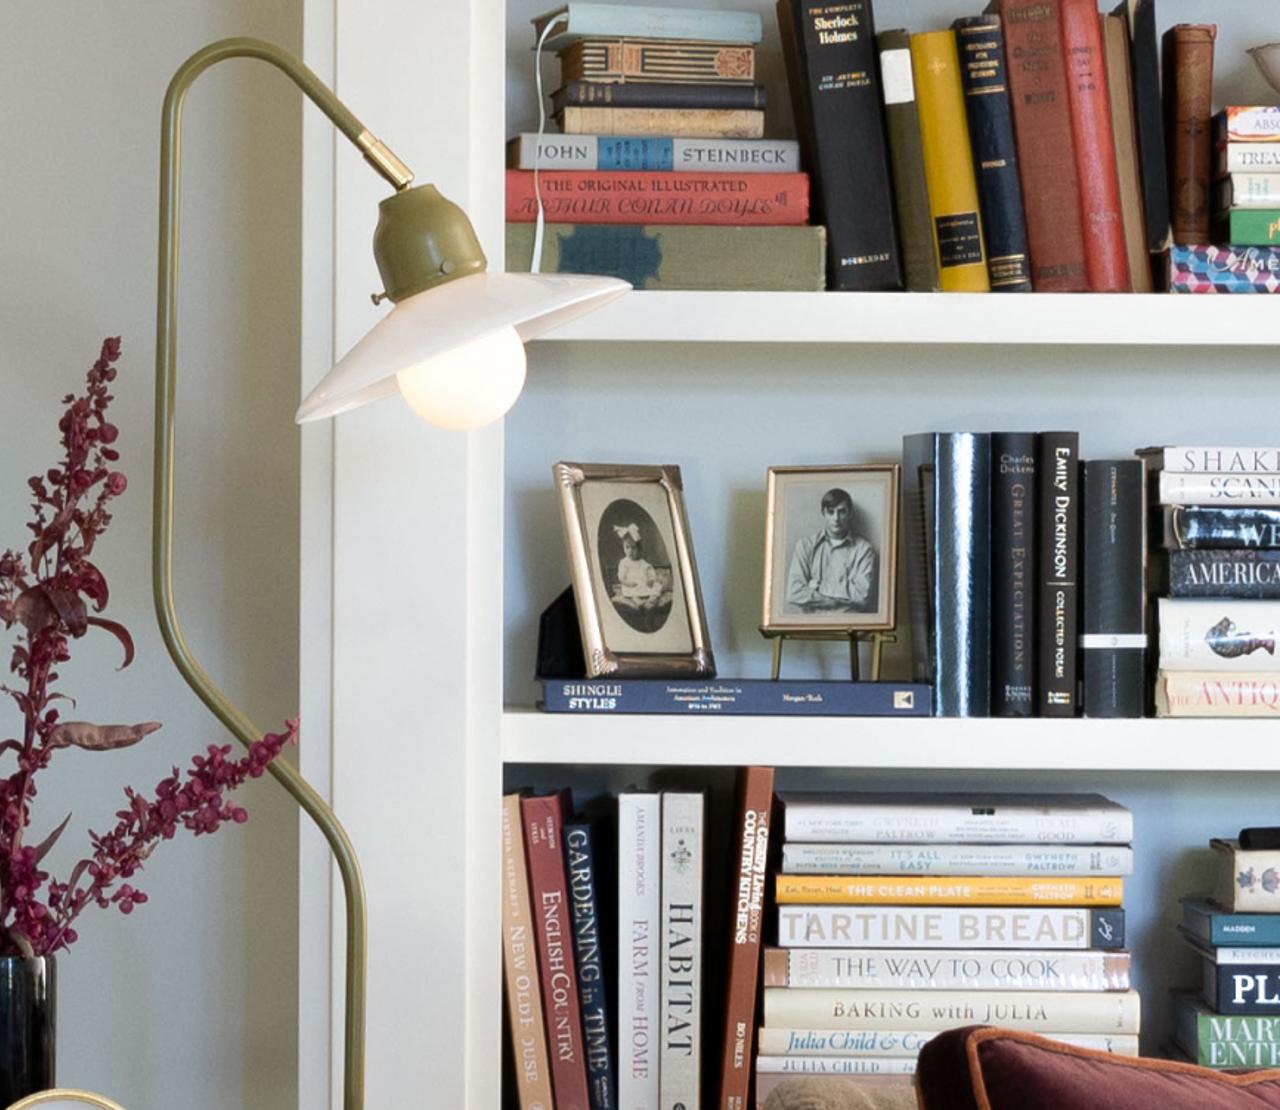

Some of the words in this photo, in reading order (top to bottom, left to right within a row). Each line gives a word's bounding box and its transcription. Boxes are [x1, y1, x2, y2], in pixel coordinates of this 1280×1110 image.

[814, 14, 859, 30] Sherlock
[819, 31, 858, 45] Holmes
[537, 144, 588, 161] JOHN
[683, 148, 786, 164] STEINBECK
[543, 179, 572, 192] THE
[577, 179, 645, 192] ORIGINAL
[651, 179, 748, 193] ILLUSTRATED
[514, 196, 610, 215] ARTHUR
[617, 197, 695, 215] CONAN
[700, 197, 774, 216] DOYLE
[1000, 453, 1034, 464] Charles
[1000, 463, 1035, 474] Dickens
[1055, 447, 1070, 491] EMILY
[1010, 484, 1025, 538] GREAT
[1054, 496, 1070, 578] DICKINSON
[1011, 547, 1026, 672] EXPECTATIONS
[1055, 590, 1065, 645] COLLECTED
[1055, 646, 1065, 679] POEMS
[563, 685, 623, 697] SHINGLE
[569, 697, 616, 710] STYLES
[740, 810, 757, 876] COUNTRY
[899, 861, 933, 872] EASY
[917, 851, 941, 861] ALL
[848, 886, 873, 897] THE
[878, 886, 926, 897] CLEAN
[929, 885, 972, 897] PLATE
[567, 829, 600, 982] GARDENING
[734, 876, 752, 945] KITCHENS
[542, 890, 563, 971] ENGLISH
[782, 914, 943, 942] TARTINE
[958, 914, 1084, 942] BREAD
[1223, 925, 1256, 933] MADDEN
[510, 924, 529, 970] NEW
[632, 919, 649, 977] FARM
[667, 902, 694, 1056] HABITAT
[831, 957, 877, 977] THE
[884, 957, 942, 978] WAY
[949, 958, 981, 978] TO
[991, 959, 1061, 979] COOK
[515, 975, 532, 1011] OLD
[582, 987, 597, 1005] in
[550, 972, 575, 1063] COUNTRY
[832, 1000, 921, 1019] BAKING
[931, 1000, 975, 1019] with
[983, 1001, 1049, 1022] JULIA
[586, 1007, 609, 1073] TIME
[632, 1015, 649, 1080] HOME
[733, 1035, 745, 1069] NILES
[786, 1030, 826, 1053] Julia
[829, 1030, 877, 1051] Child
[879, 1033, 904, 1052] &
[783, 1060, 827, 1074] JULIA
[832, 1060, 880, 1074] CHILD
